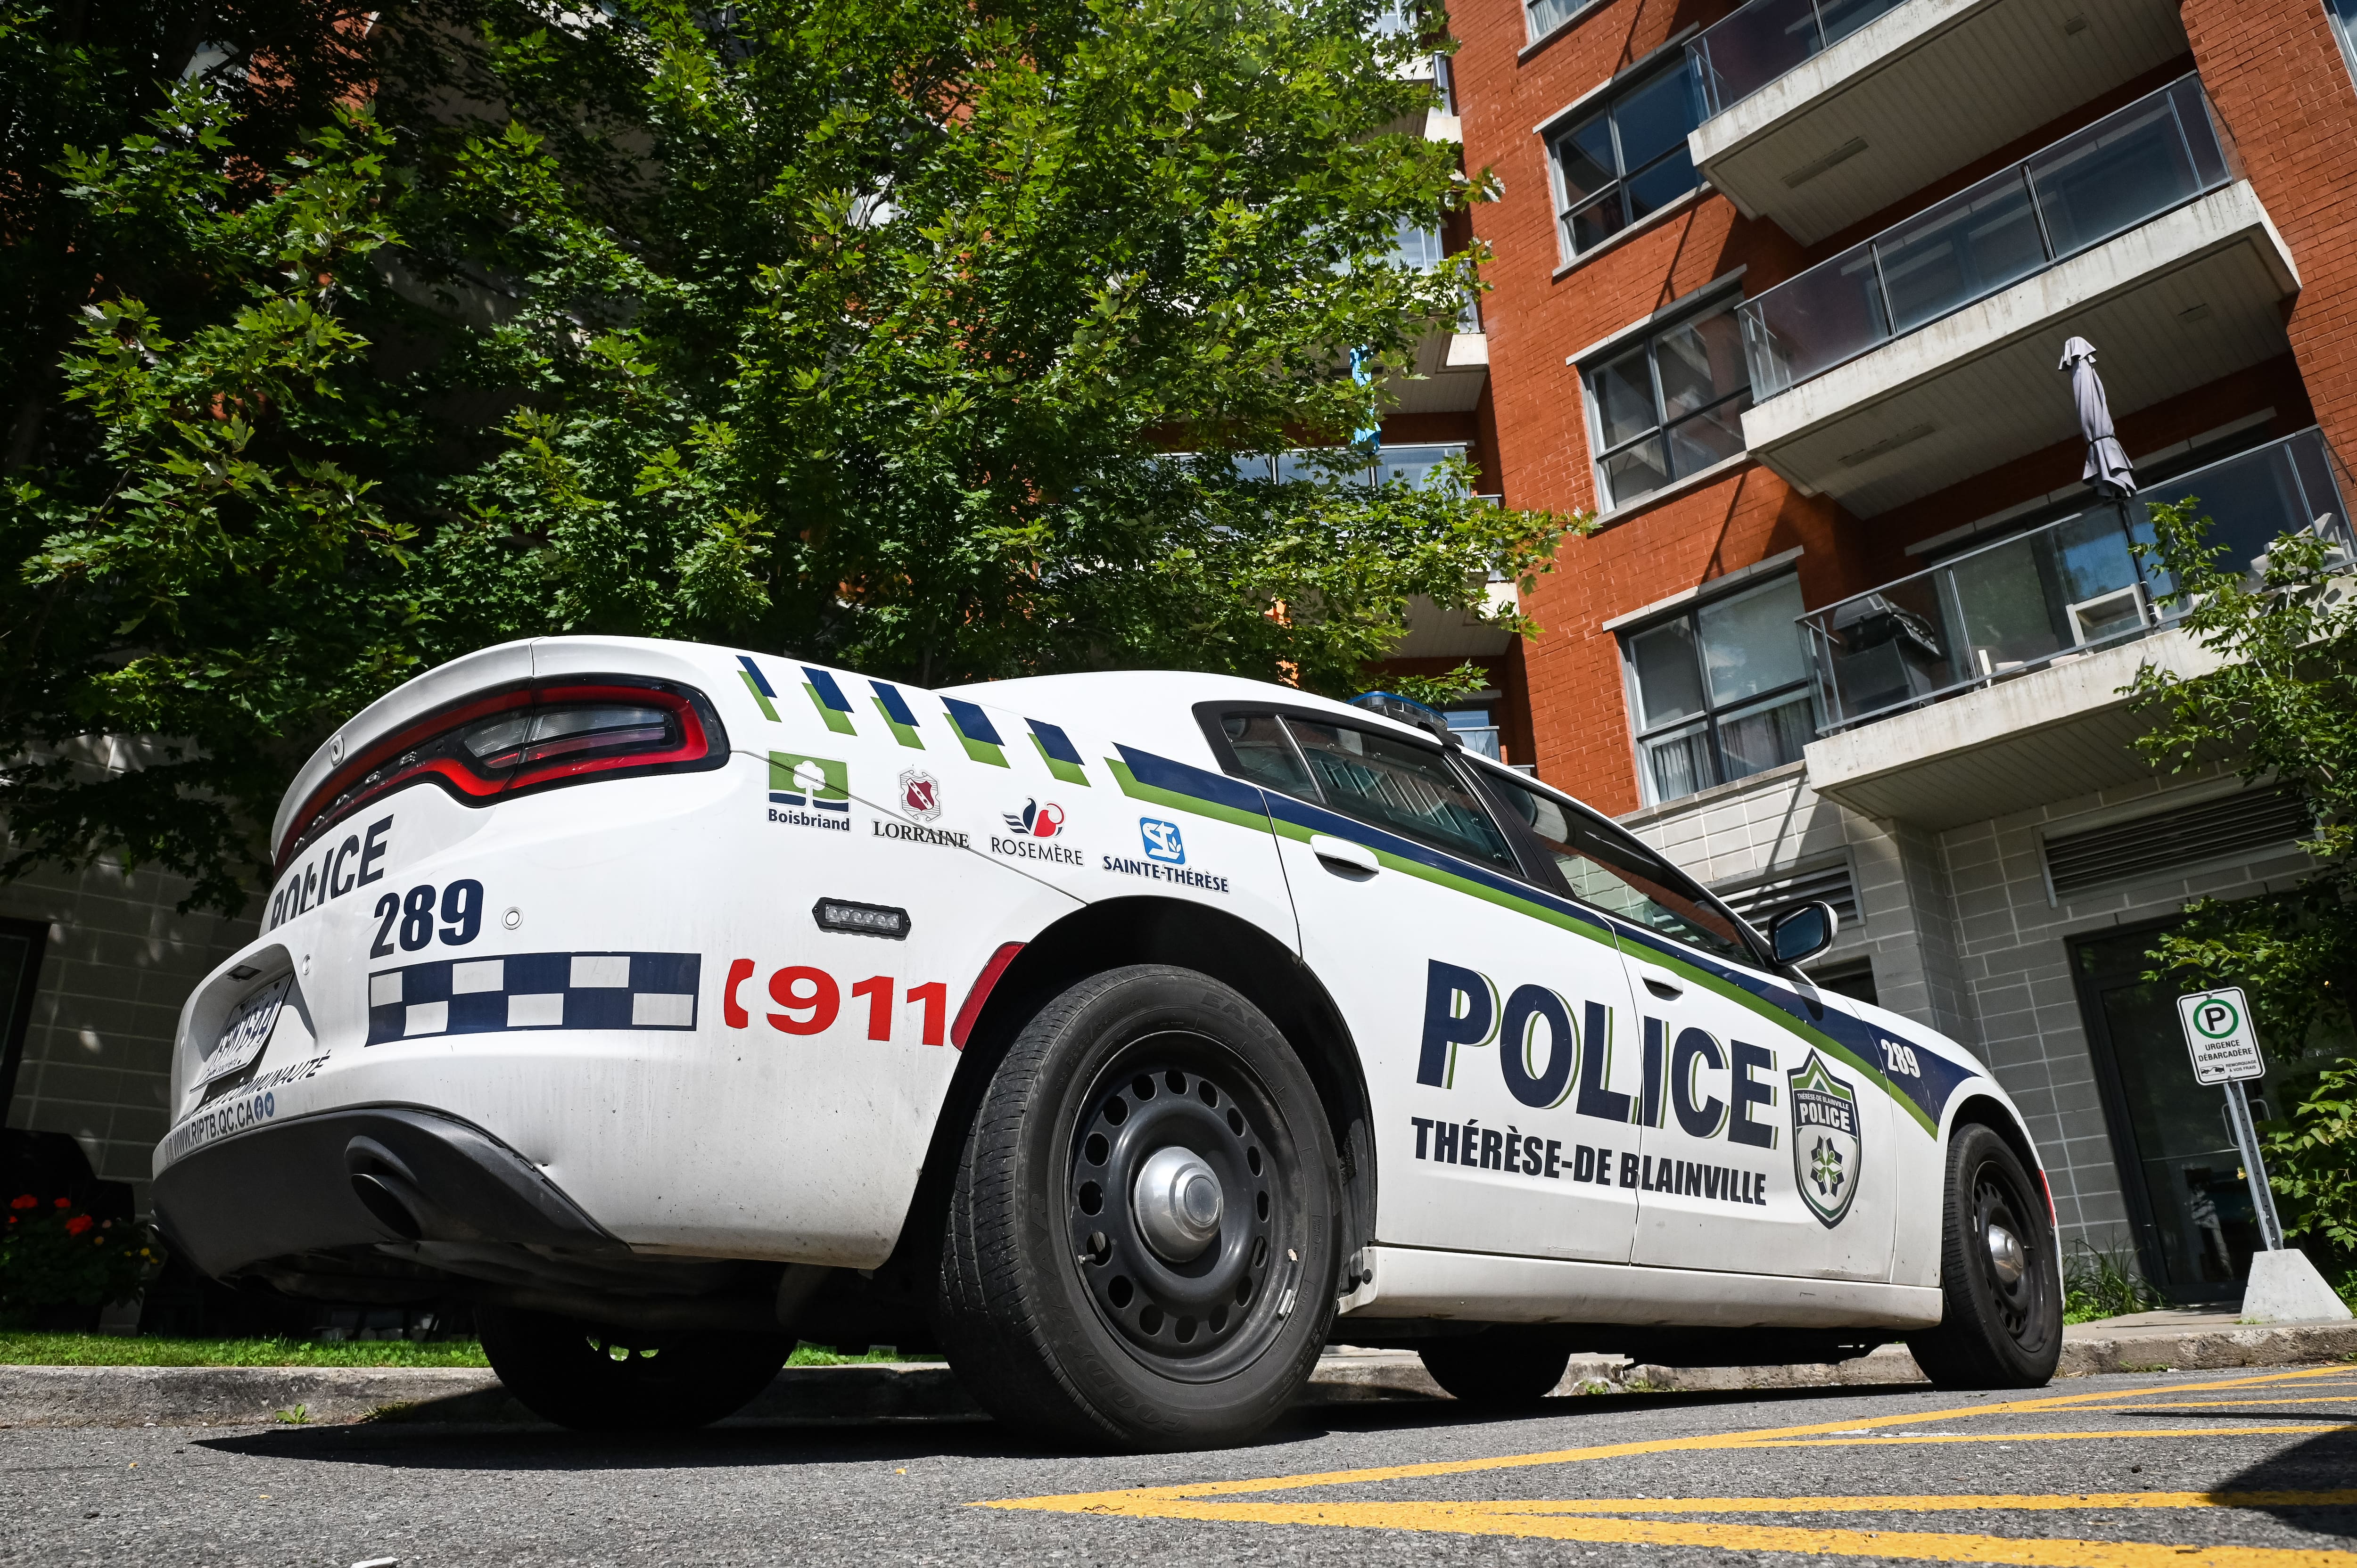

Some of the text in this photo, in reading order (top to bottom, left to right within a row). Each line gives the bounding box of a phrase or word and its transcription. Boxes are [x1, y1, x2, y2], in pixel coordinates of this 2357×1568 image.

[768, 809, 849, 831] Boisbriand
[873, 821, 970, 848] LORRAINE
[991, 837, 1084, 866] ROSEMÈRE
[270, 813, 394, 931] POLICE
[1103, 855, 1229, 893] SAINTE-THÉRÈSE
[370, 878, 484, 960] 289
[766, 966, 946, 1046] 911
[2205, 1007, 2226, 1032] P
[1416, 959, 1779, 1149] POLICE
[1880, 1039, 1920, 1078] 289
[2198, 1048, 2253, 1062] DÉBARCADÈRE
[2205, 1039, 2241, 1051] URGENCE
[1799, 1102, 1851, 1132] POLICE
[1822, 1096, 1849, 1110] BLAINVILLE
[173, 1100, 255, 1157] WWW.RIPTB.QC.CA
[1411, 1116, 1767, 1206] THÉRÈSE-DE BLAINVILLE
